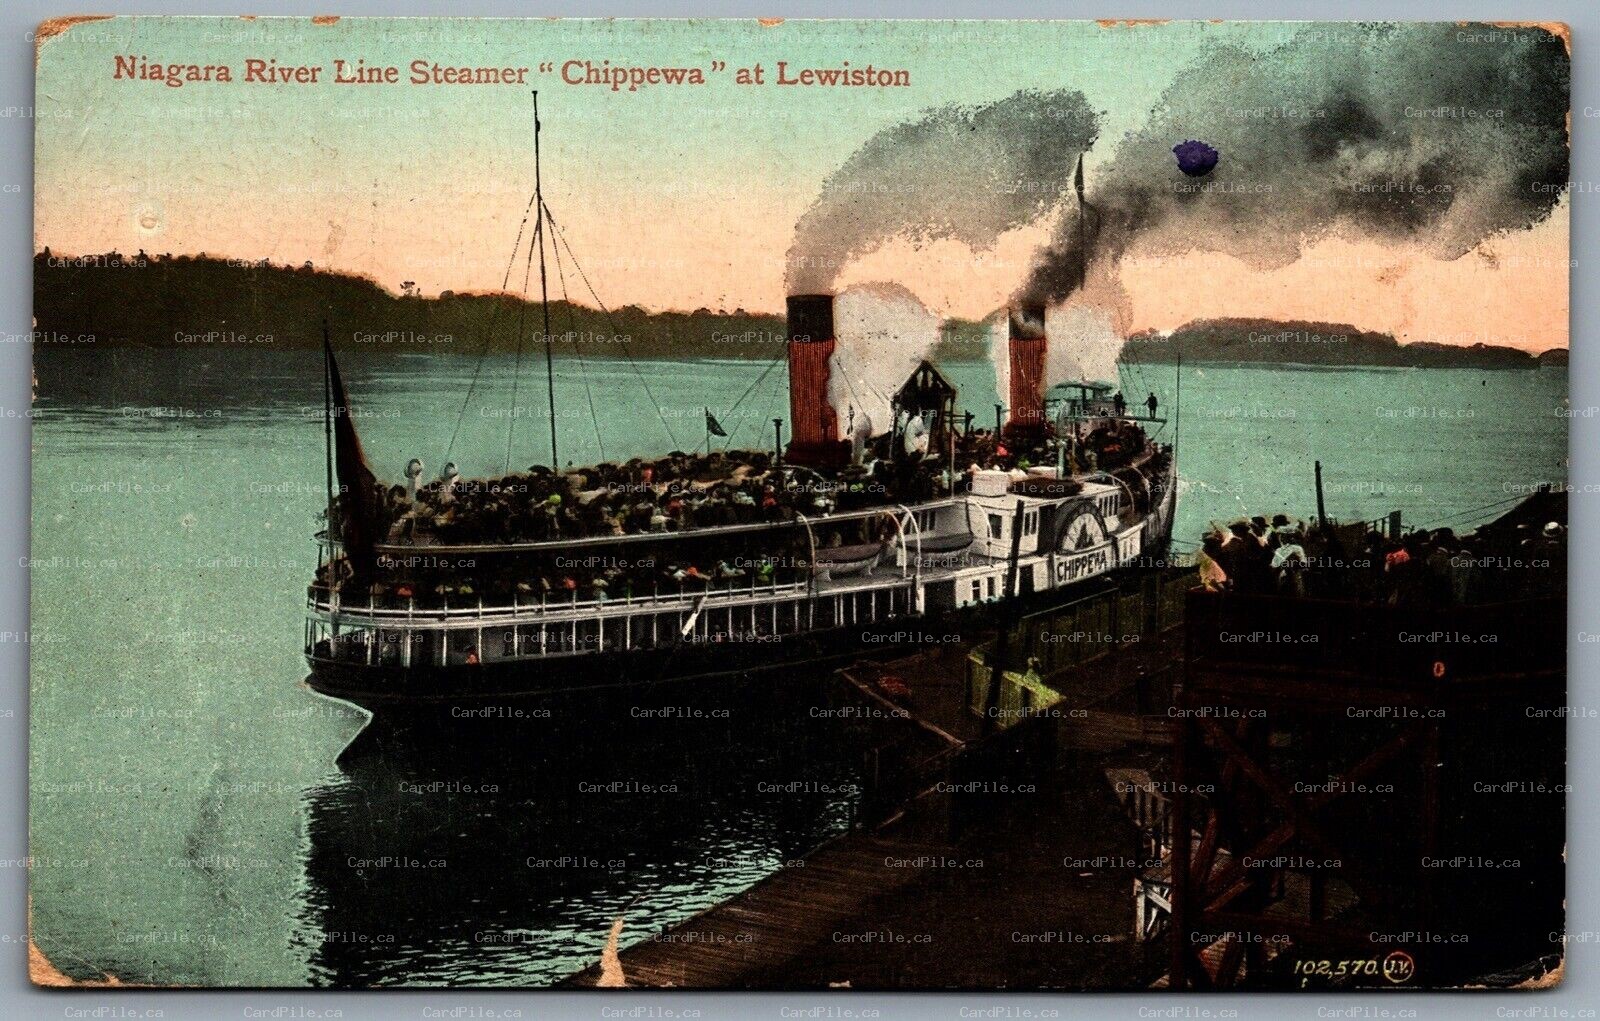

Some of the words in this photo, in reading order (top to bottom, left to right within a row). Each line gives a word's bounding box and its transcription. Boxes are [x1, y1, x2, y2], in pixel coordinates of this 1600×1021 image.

[113, 55, 232, 88] Niagara
[244, 59, 322, 84] River
[333, 59, 399, 84] Line
[410, 60, 528, 84] Steamer
[735, 63, 765, 86] at
[777, 61, 911, 87] Lewiston
